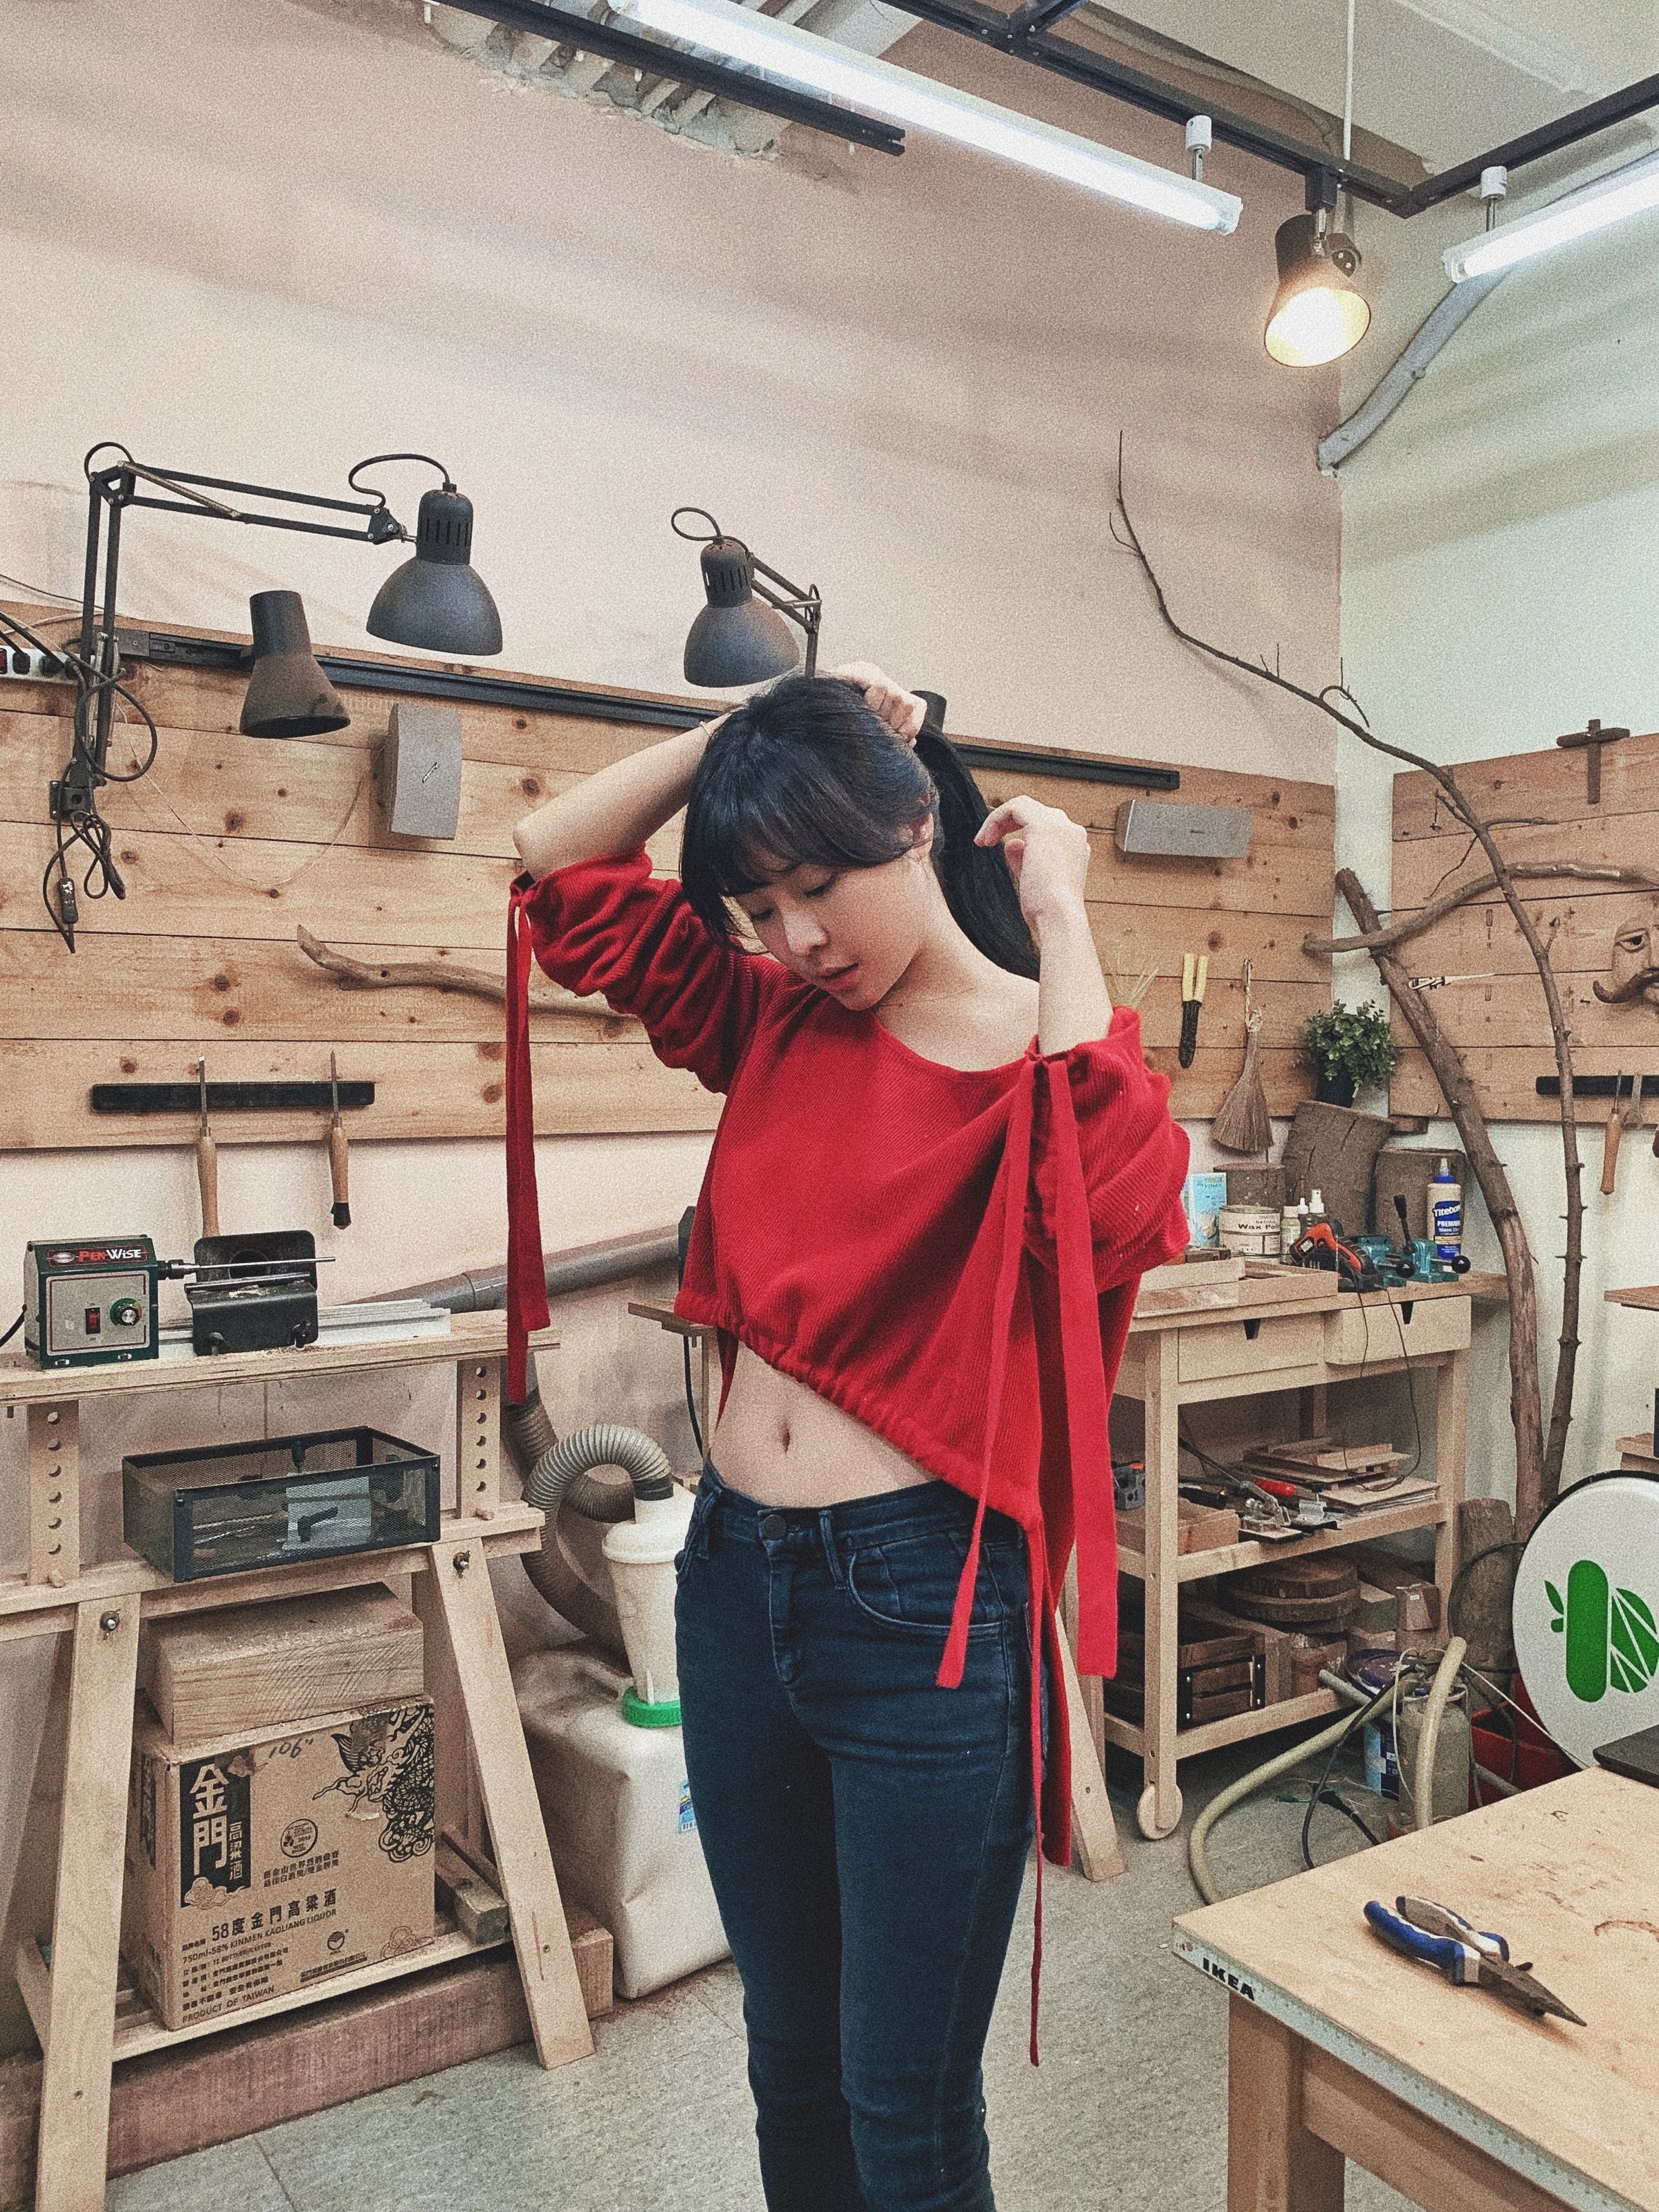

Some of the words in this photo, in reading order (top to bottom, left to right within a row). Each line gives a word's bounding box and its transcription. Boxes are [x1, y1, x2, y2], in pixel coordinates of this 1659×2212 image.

[190, 1763, 230, 1877] 金門
[230, 1932, 263, 1949] KINMEN
[265, 1919, 306, 1937] KAOLIANG
[306, 1908, 337, 1924] LIQUOR
[1202, 1957, 1255, 2001] IKEA
[182, 2003, 223, 2024] PRODUCT
[226, 1998, 239, 2008] OF
[242, 1986, 275, 2002] TAIWAN
